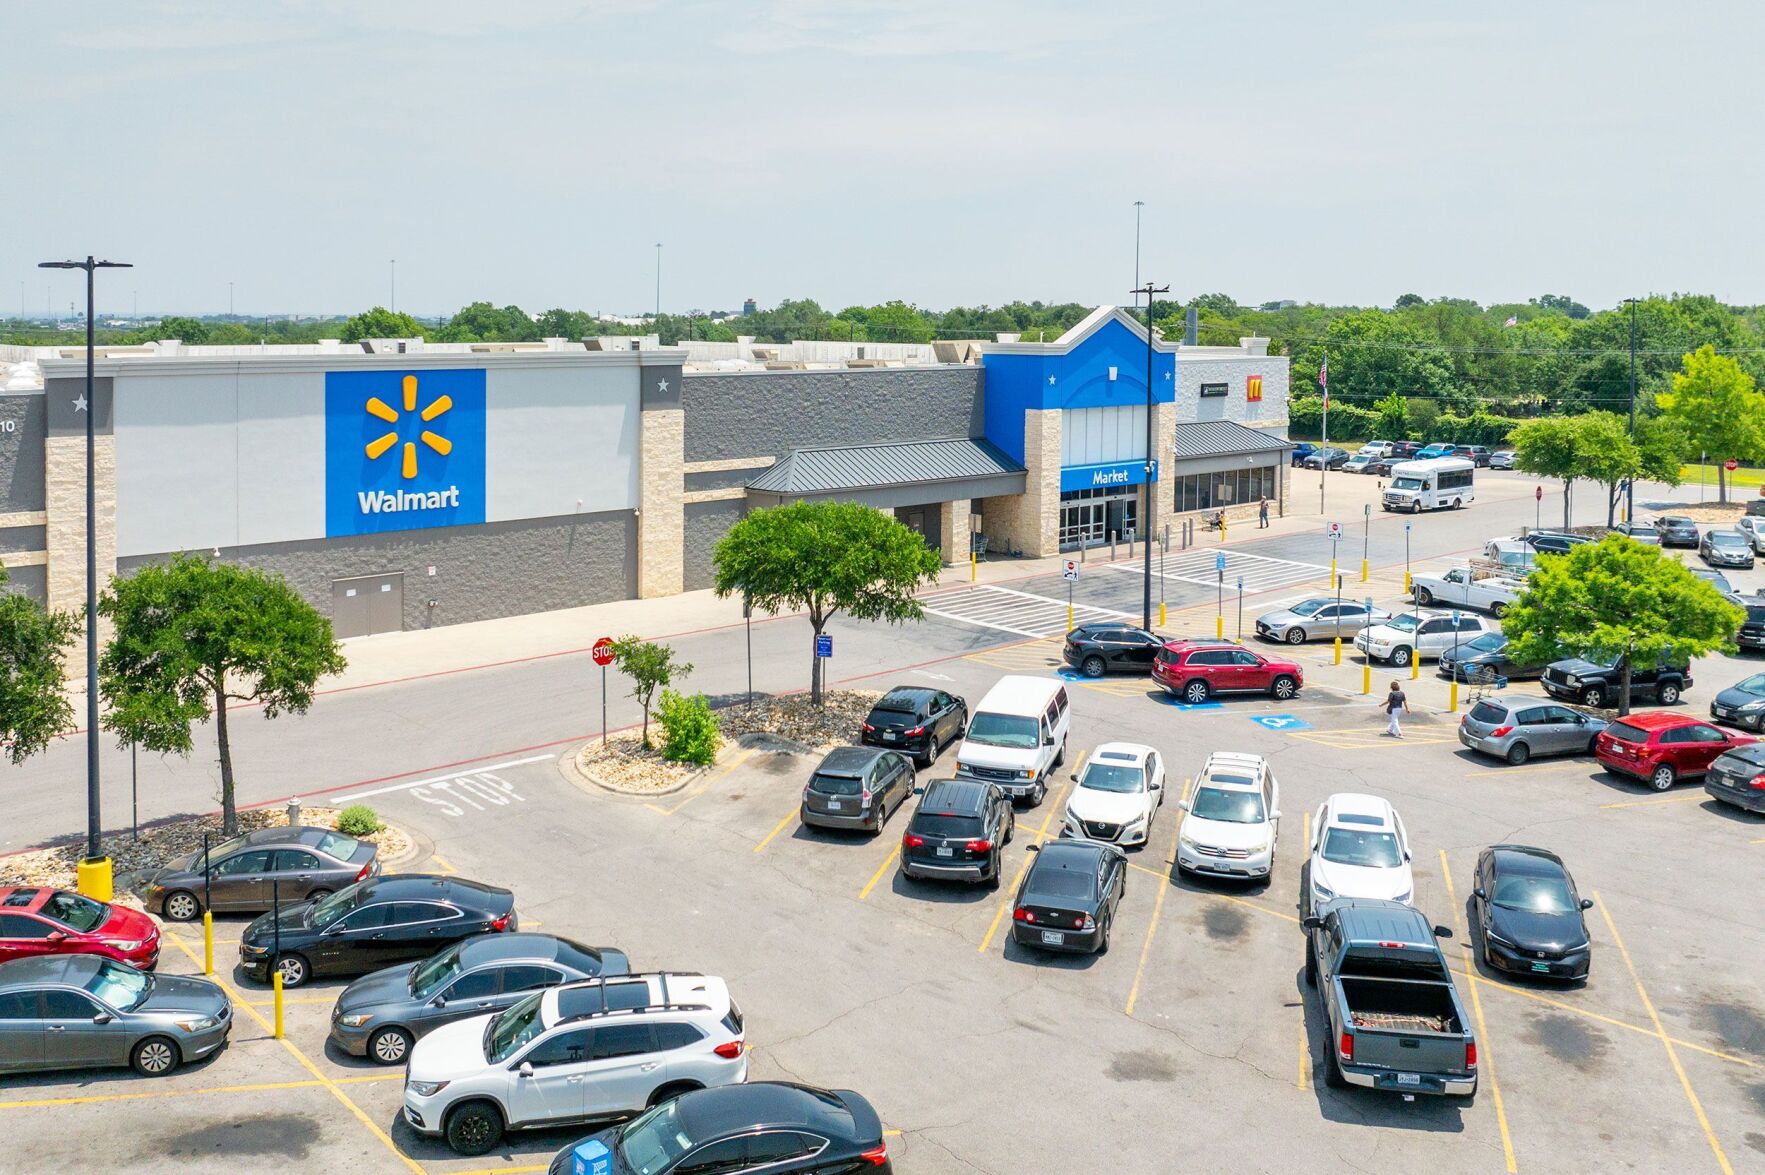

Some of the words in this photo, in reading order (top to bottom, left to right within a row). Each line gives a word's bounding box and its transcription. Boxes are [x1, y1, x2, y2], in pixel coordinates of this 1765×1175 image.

[1093, 469, 1129, 485] Market
[358, 485, 460, 514] Walmart
[410, 773, 526, 816] STOP
